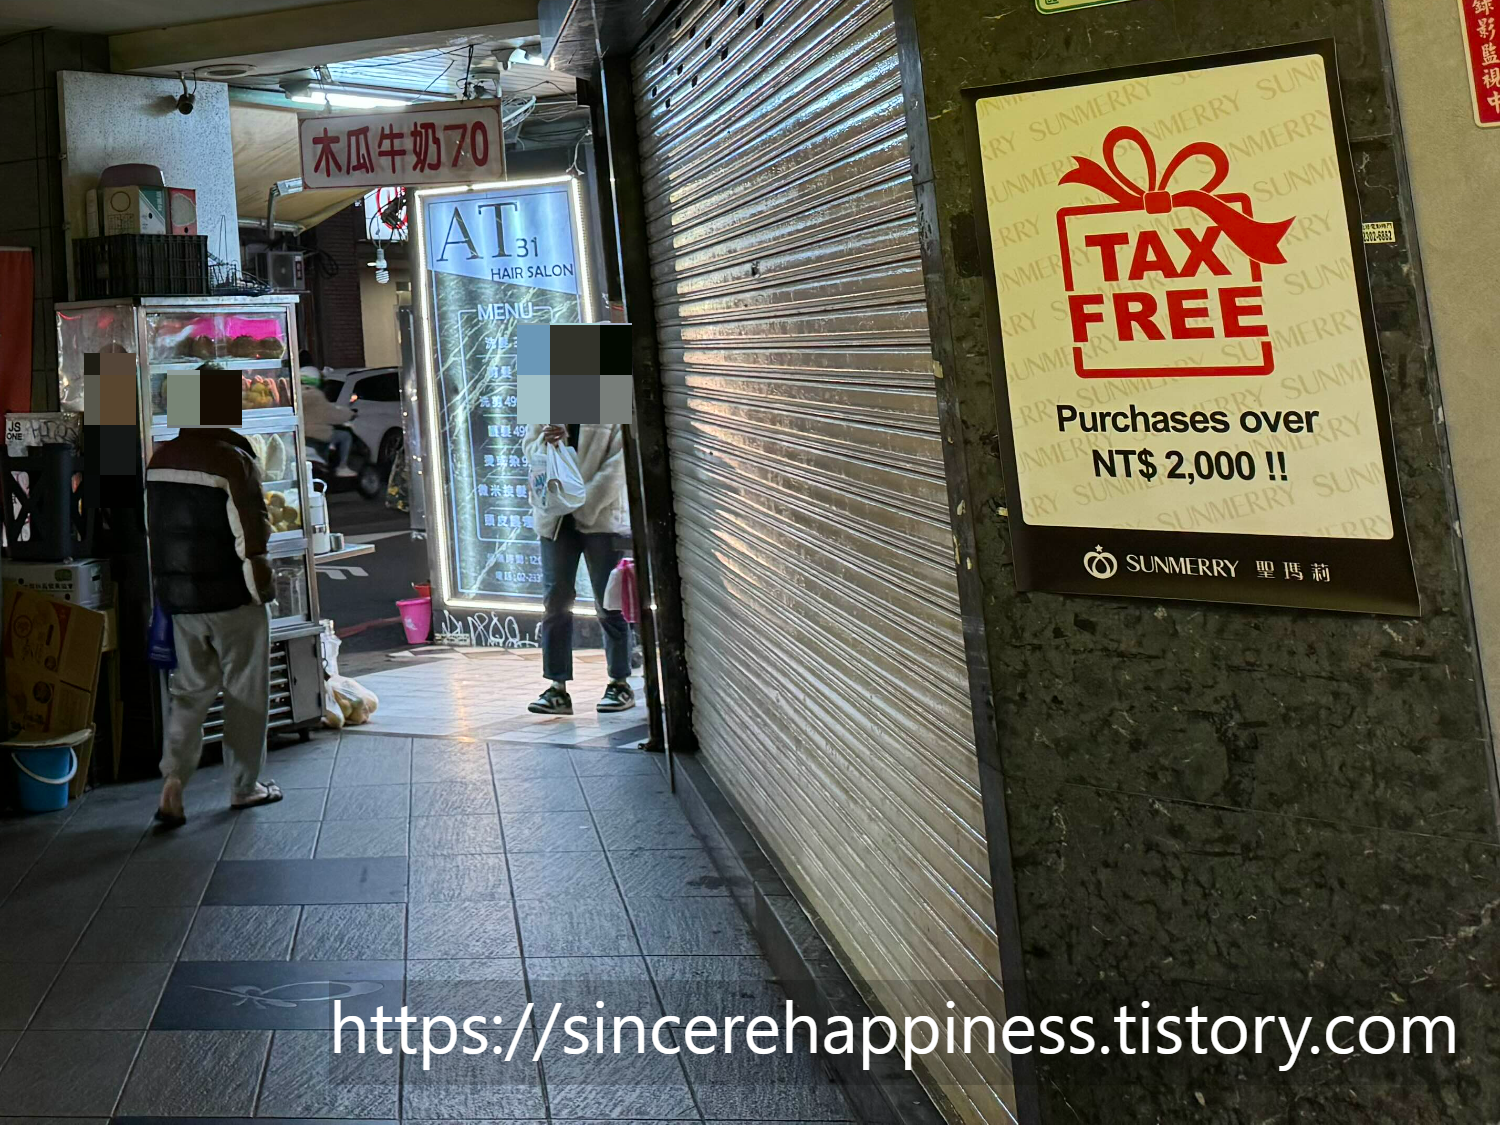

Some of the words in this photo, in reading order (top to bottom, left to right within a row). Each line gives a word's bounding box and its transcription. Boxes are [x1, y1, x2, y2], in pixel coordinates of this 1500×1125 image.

[1028, 77, 1153, 142] SUNMERRY
[491, 267, 525, 281] HAIR
[527, 263, 574, 279] SALON
[1084, 227, 1232, 283] TAX
[477, 301, 534, 321] MENU
[1068, 286, 1270, 343] FREE
[1056, 403, 1231, 434] Purchases
[1239, 409, 1320, 434] over
[1091, 447, 1158, 483] NT$
[1164, 450, 1257, 486] 2,000
[1265, 451, 1289, 482] !!
[1125, 554, 1240, 579] SUNMERRY
[1255, 560, 1332, 583] 聖瑪莉
